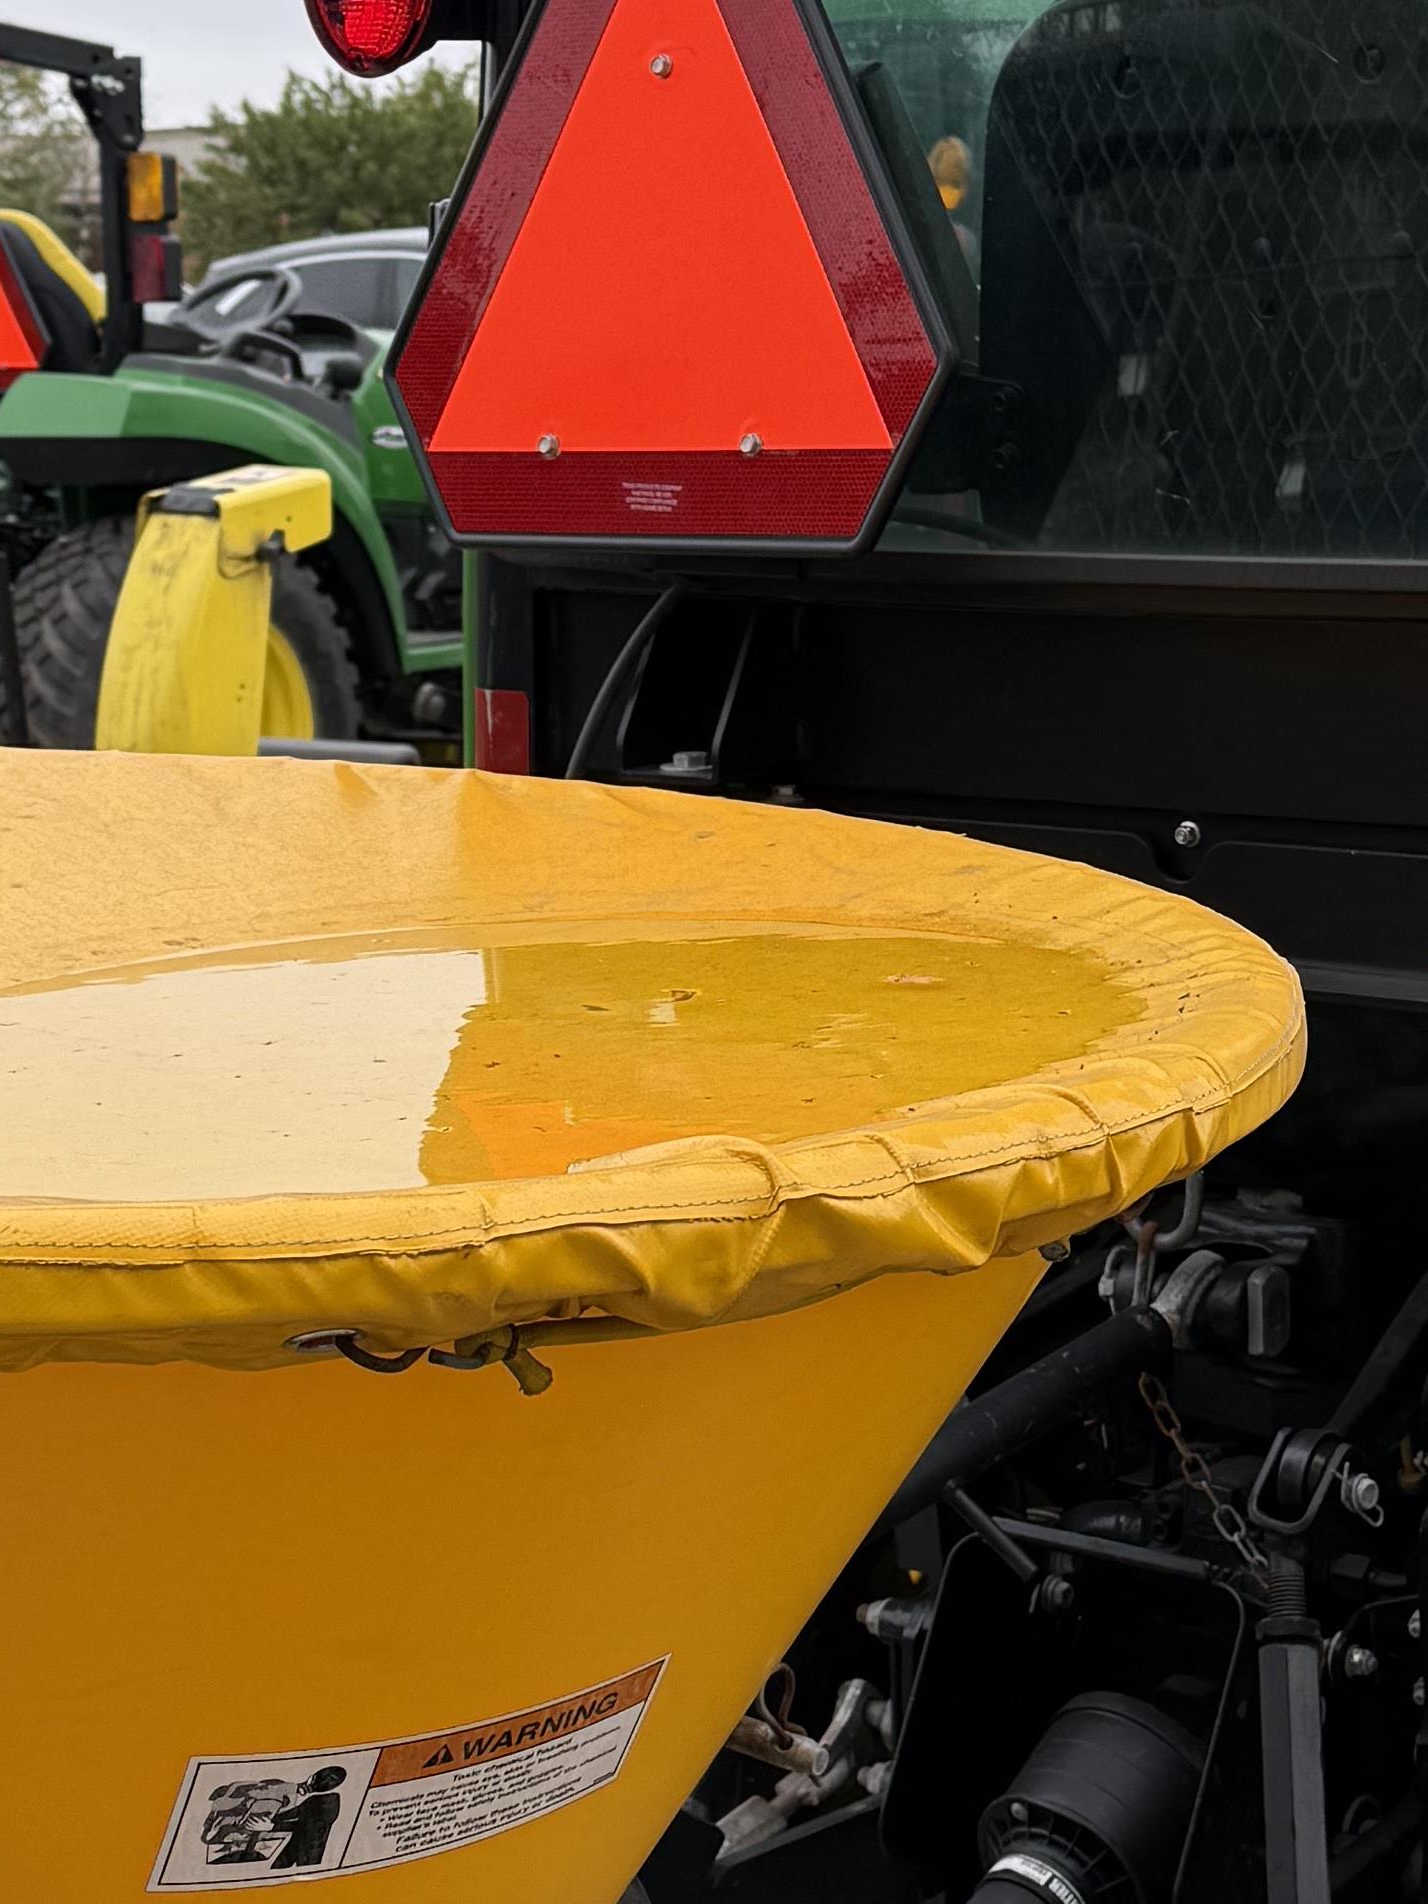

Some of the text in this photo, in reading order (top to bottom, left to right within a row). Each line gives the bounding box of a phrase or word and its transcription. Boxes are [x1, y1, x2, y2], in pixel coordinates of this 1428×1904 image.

[461, 1692, 619, 1760] WARNING
[485, 1751, 535, 1773] chemical
[396, 1829, 436, 1844] Failure
[420, 1833, 454, 1847] cause
